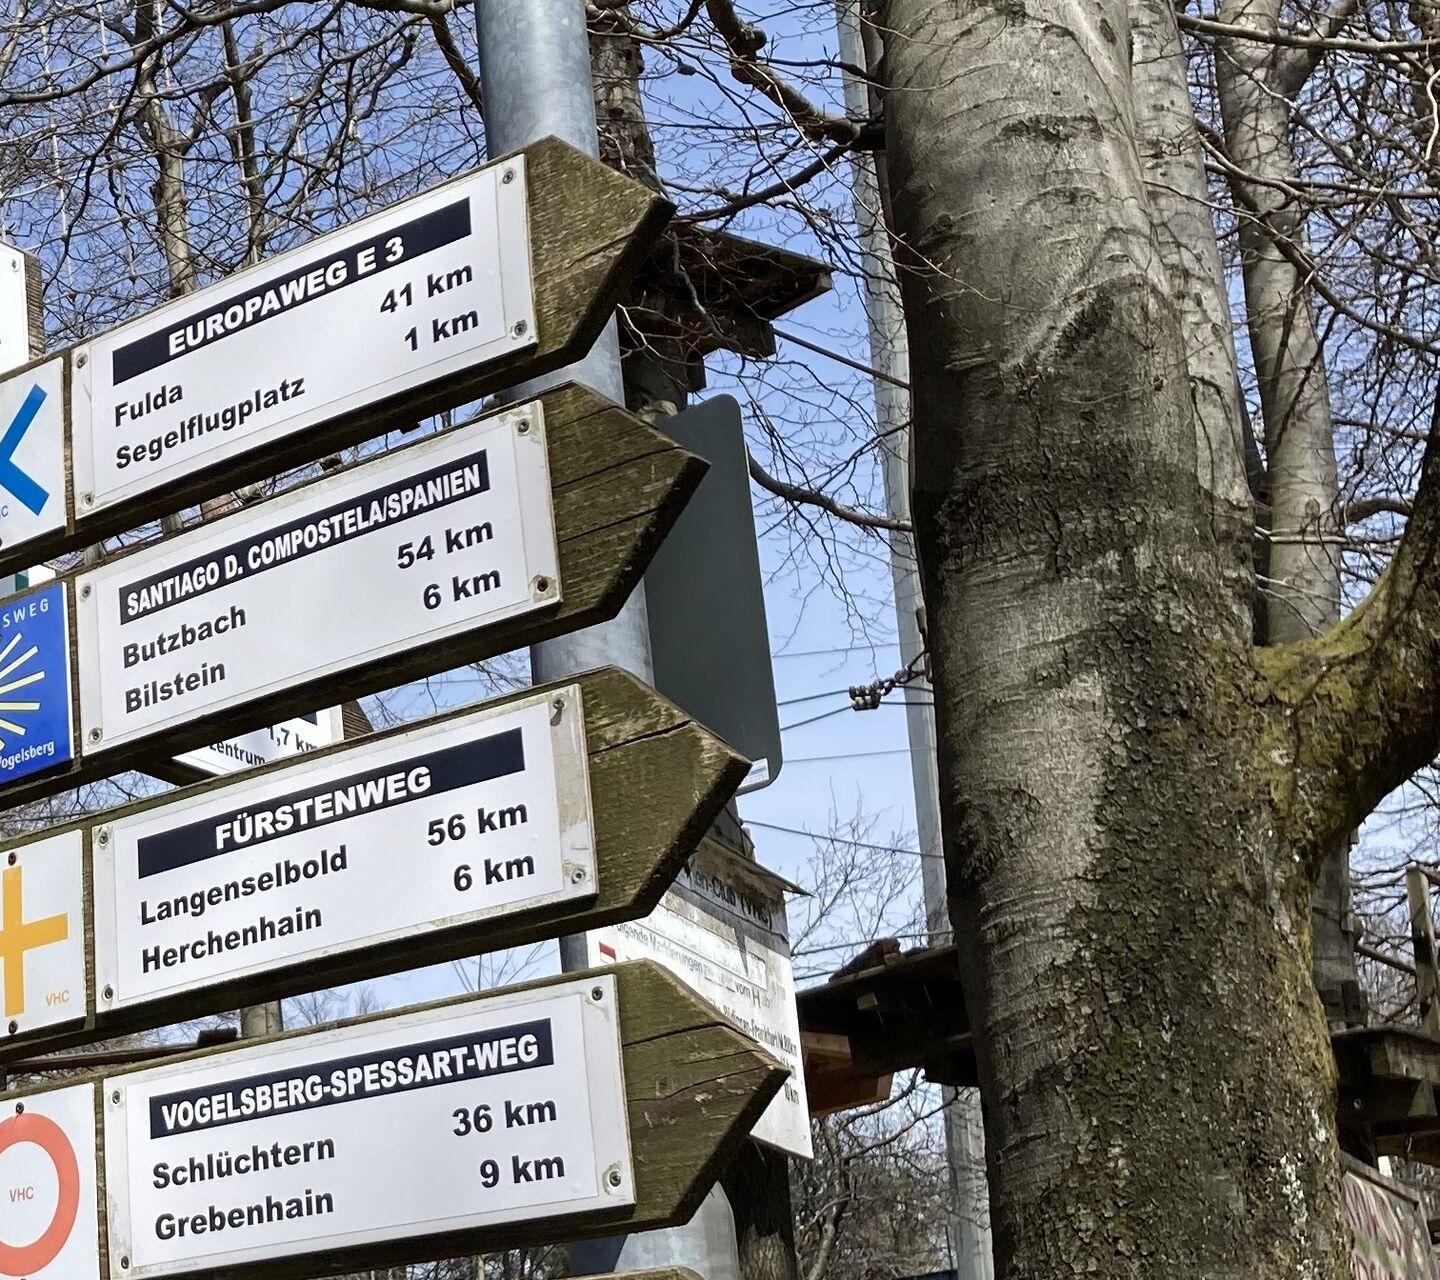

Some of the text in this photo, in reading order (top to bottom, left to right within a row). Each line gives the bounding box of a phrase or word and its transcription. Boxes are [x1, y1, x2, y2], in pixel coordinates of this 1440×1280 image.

[168, 236, 405, 356] EUROPAWEG E 3
[380, 260, 474, 316] 41 km
[405, 305, 479, 354] 1 km
[114, 381, 184, 428] Fulda
[115, 374, 306, 471] Segelflugplatz
[126, 463, 480, 616] SANTIAGO D. COMPOSTELA/SPANIEN
[123, 520, 494, 669] Butzbach 54 km
[125, 567, 502, 715] Bilstein 6 km
[215, 765, 432, 850] FÜRSTENWEG
[141, 801, 528, 926] Langenselbold 56 km
[142, 851, 535, 974] Herchenhain 6 km
[45, 990, 70, 1005] VHC
[161, 1034, 539, 1131] VOGELSBERG-SPESSART-WEG
[152, 1100, 557, 1190] Schlüchtern 36 km
[9, 1187, 34, 1201] VHC
[155, 1153, 565, 1242] Grebenhain 9 km
